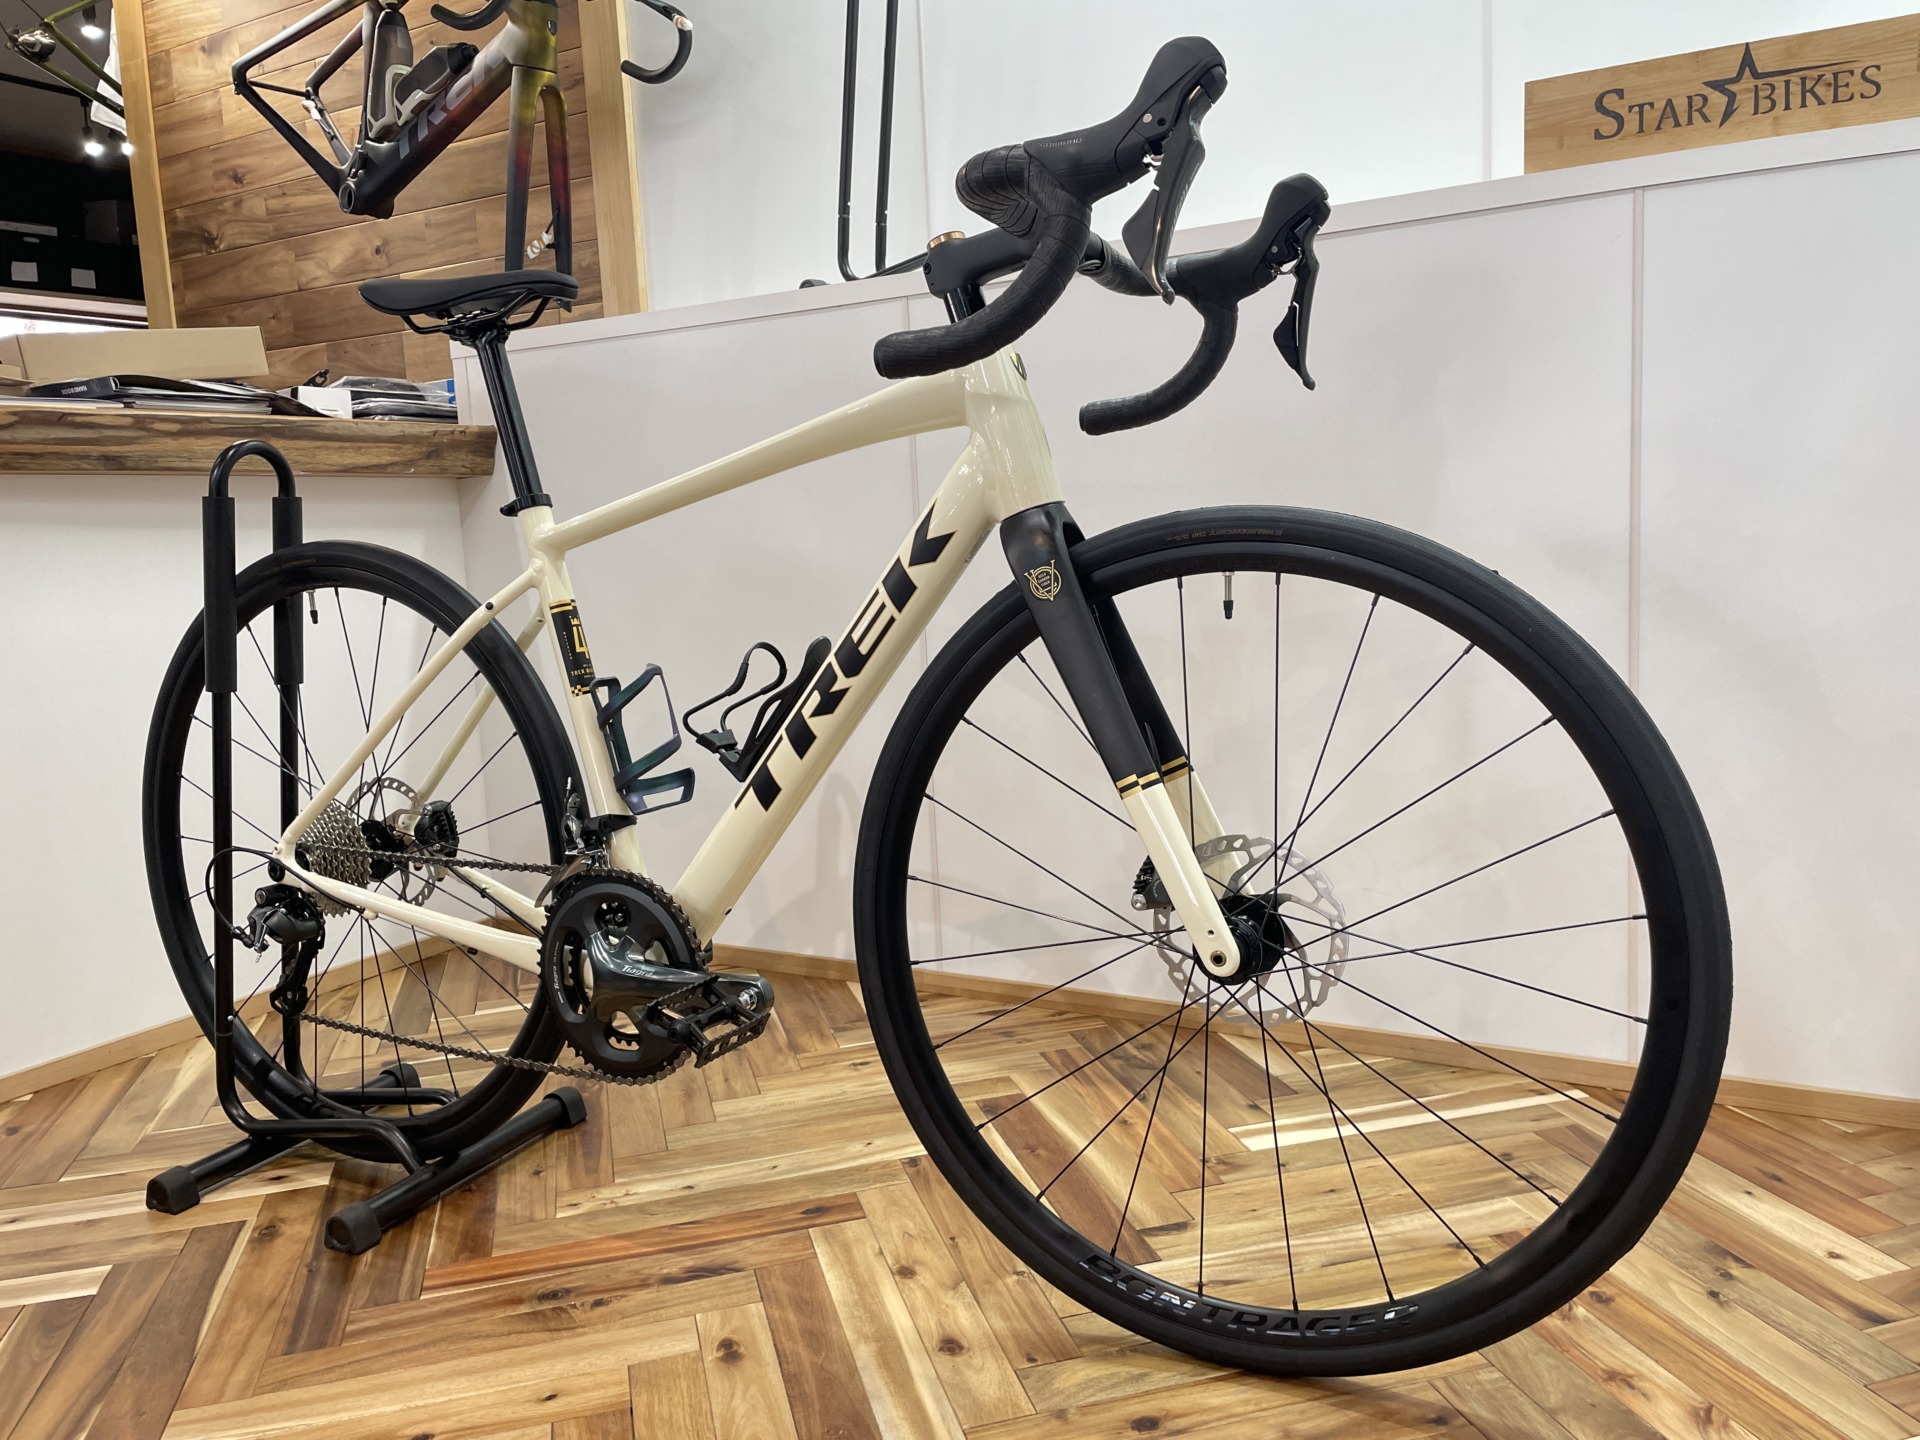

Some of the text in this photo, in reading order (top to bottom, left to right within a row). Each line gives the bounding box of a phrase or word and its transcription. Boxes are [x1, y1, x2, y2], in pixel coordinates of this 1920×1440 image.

[1751, 64, 1882, 116] BIKES
[734, 498, 957, 812] TREK
[621, 964, 654, 977] Tiagra
